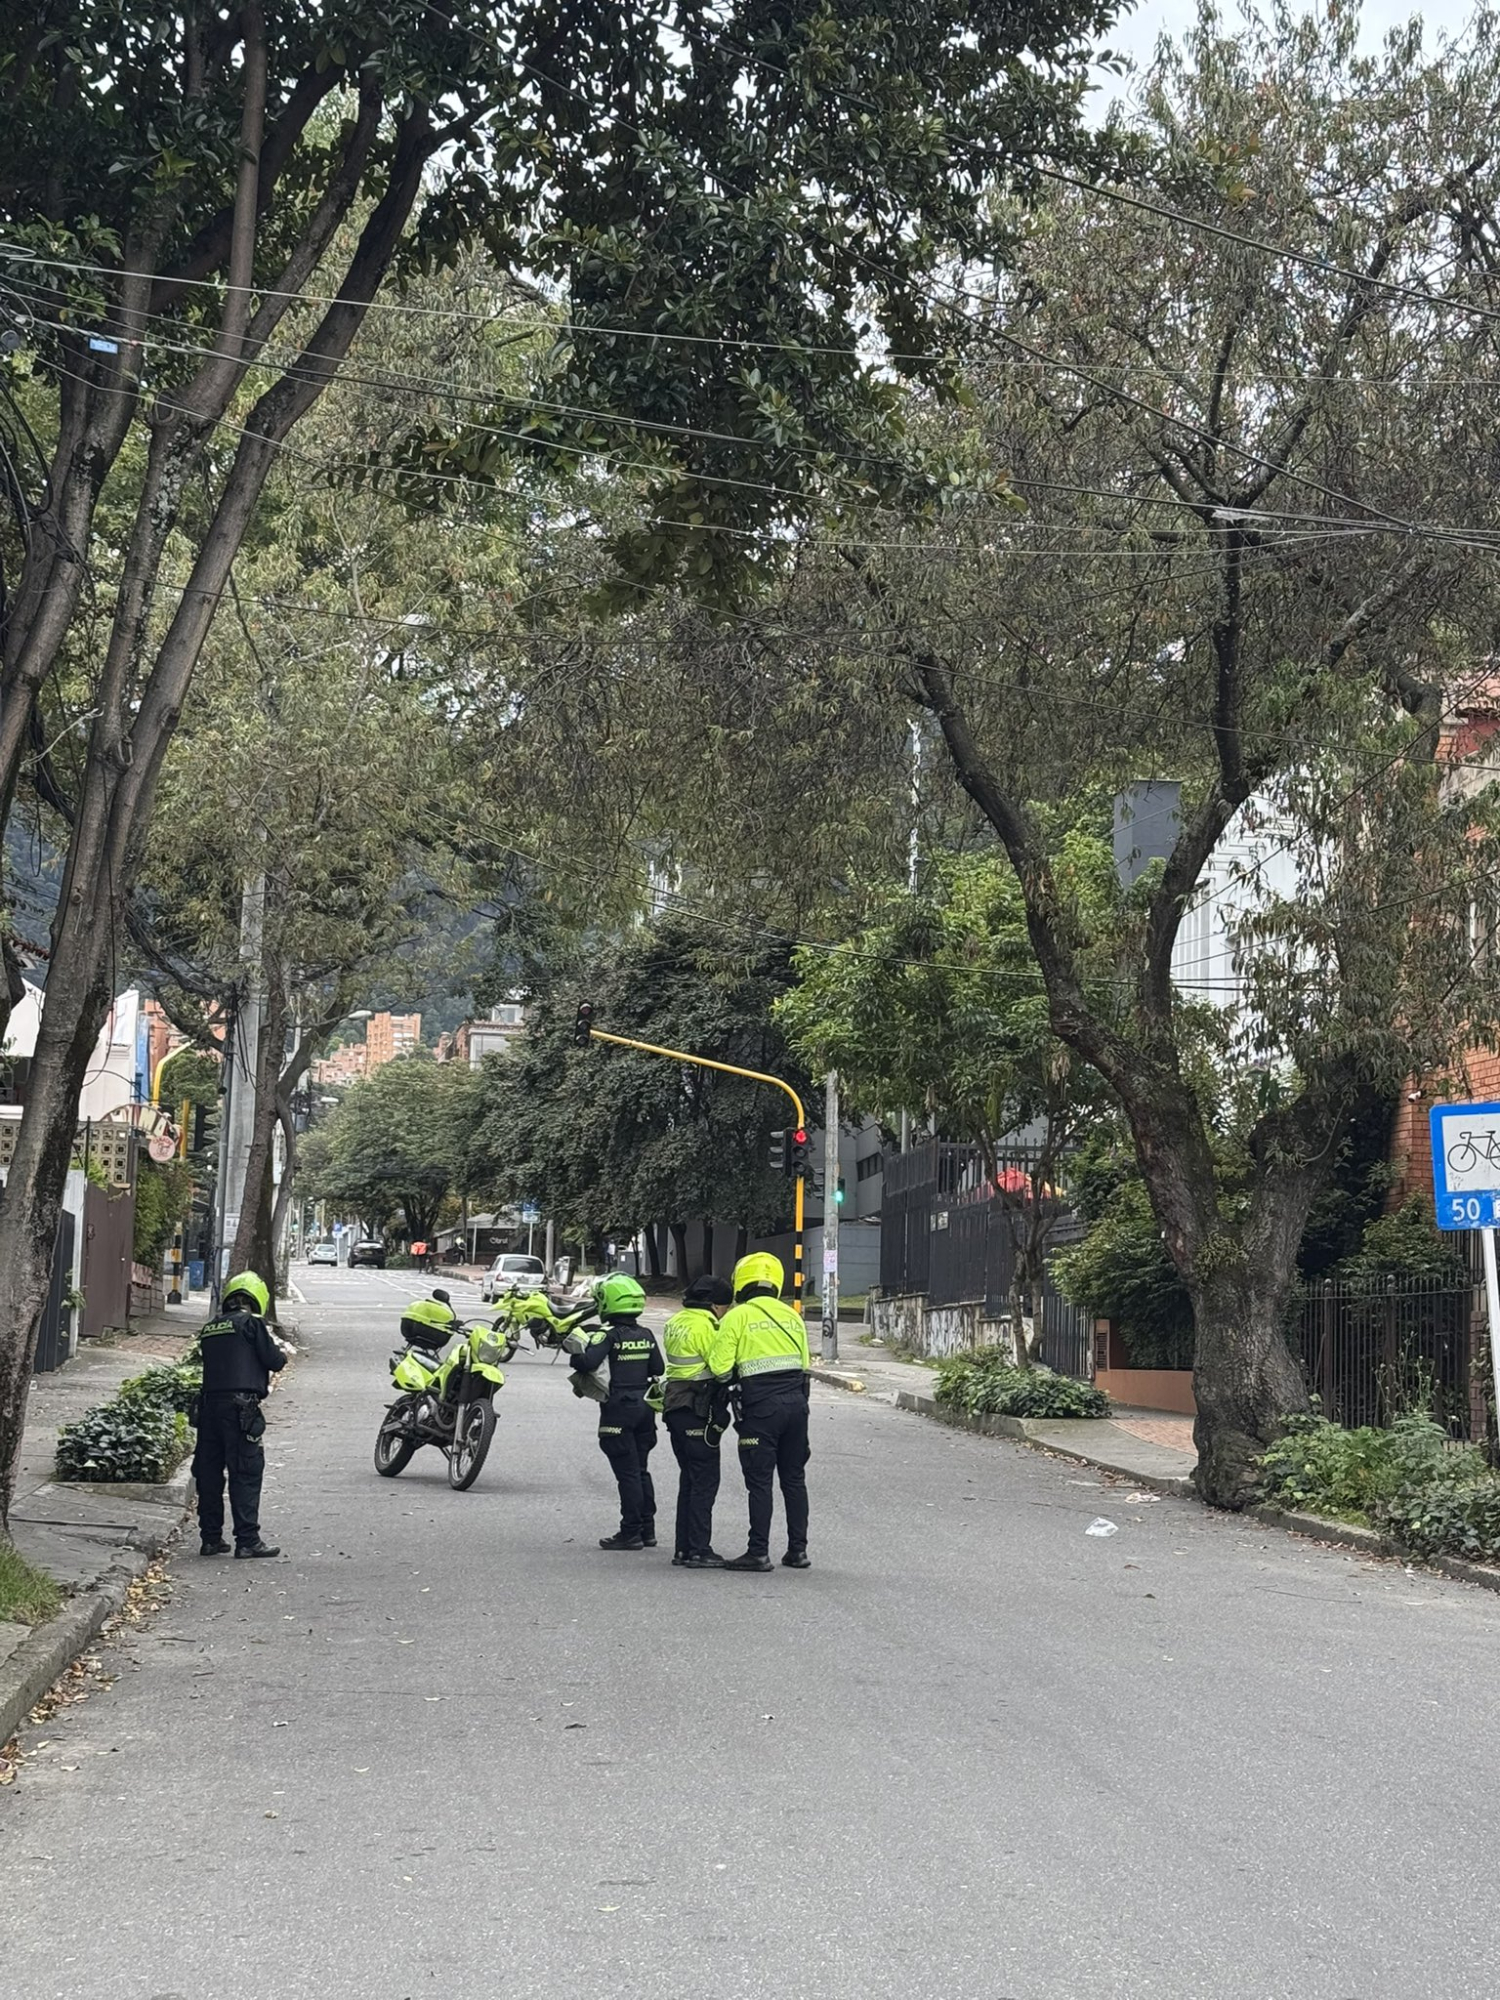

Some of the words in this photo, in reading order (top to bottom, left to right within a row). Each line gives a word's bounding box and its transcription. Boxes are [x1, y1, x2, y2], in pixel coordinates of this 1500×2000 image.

[1452, 1197, 1480, 1221] 50
[203, 1319, 233, 1333] POLICÍA
[748, 1318, 803, 1332] POLCÍA
[621, 1338, 650, 1350] POLICÍA
